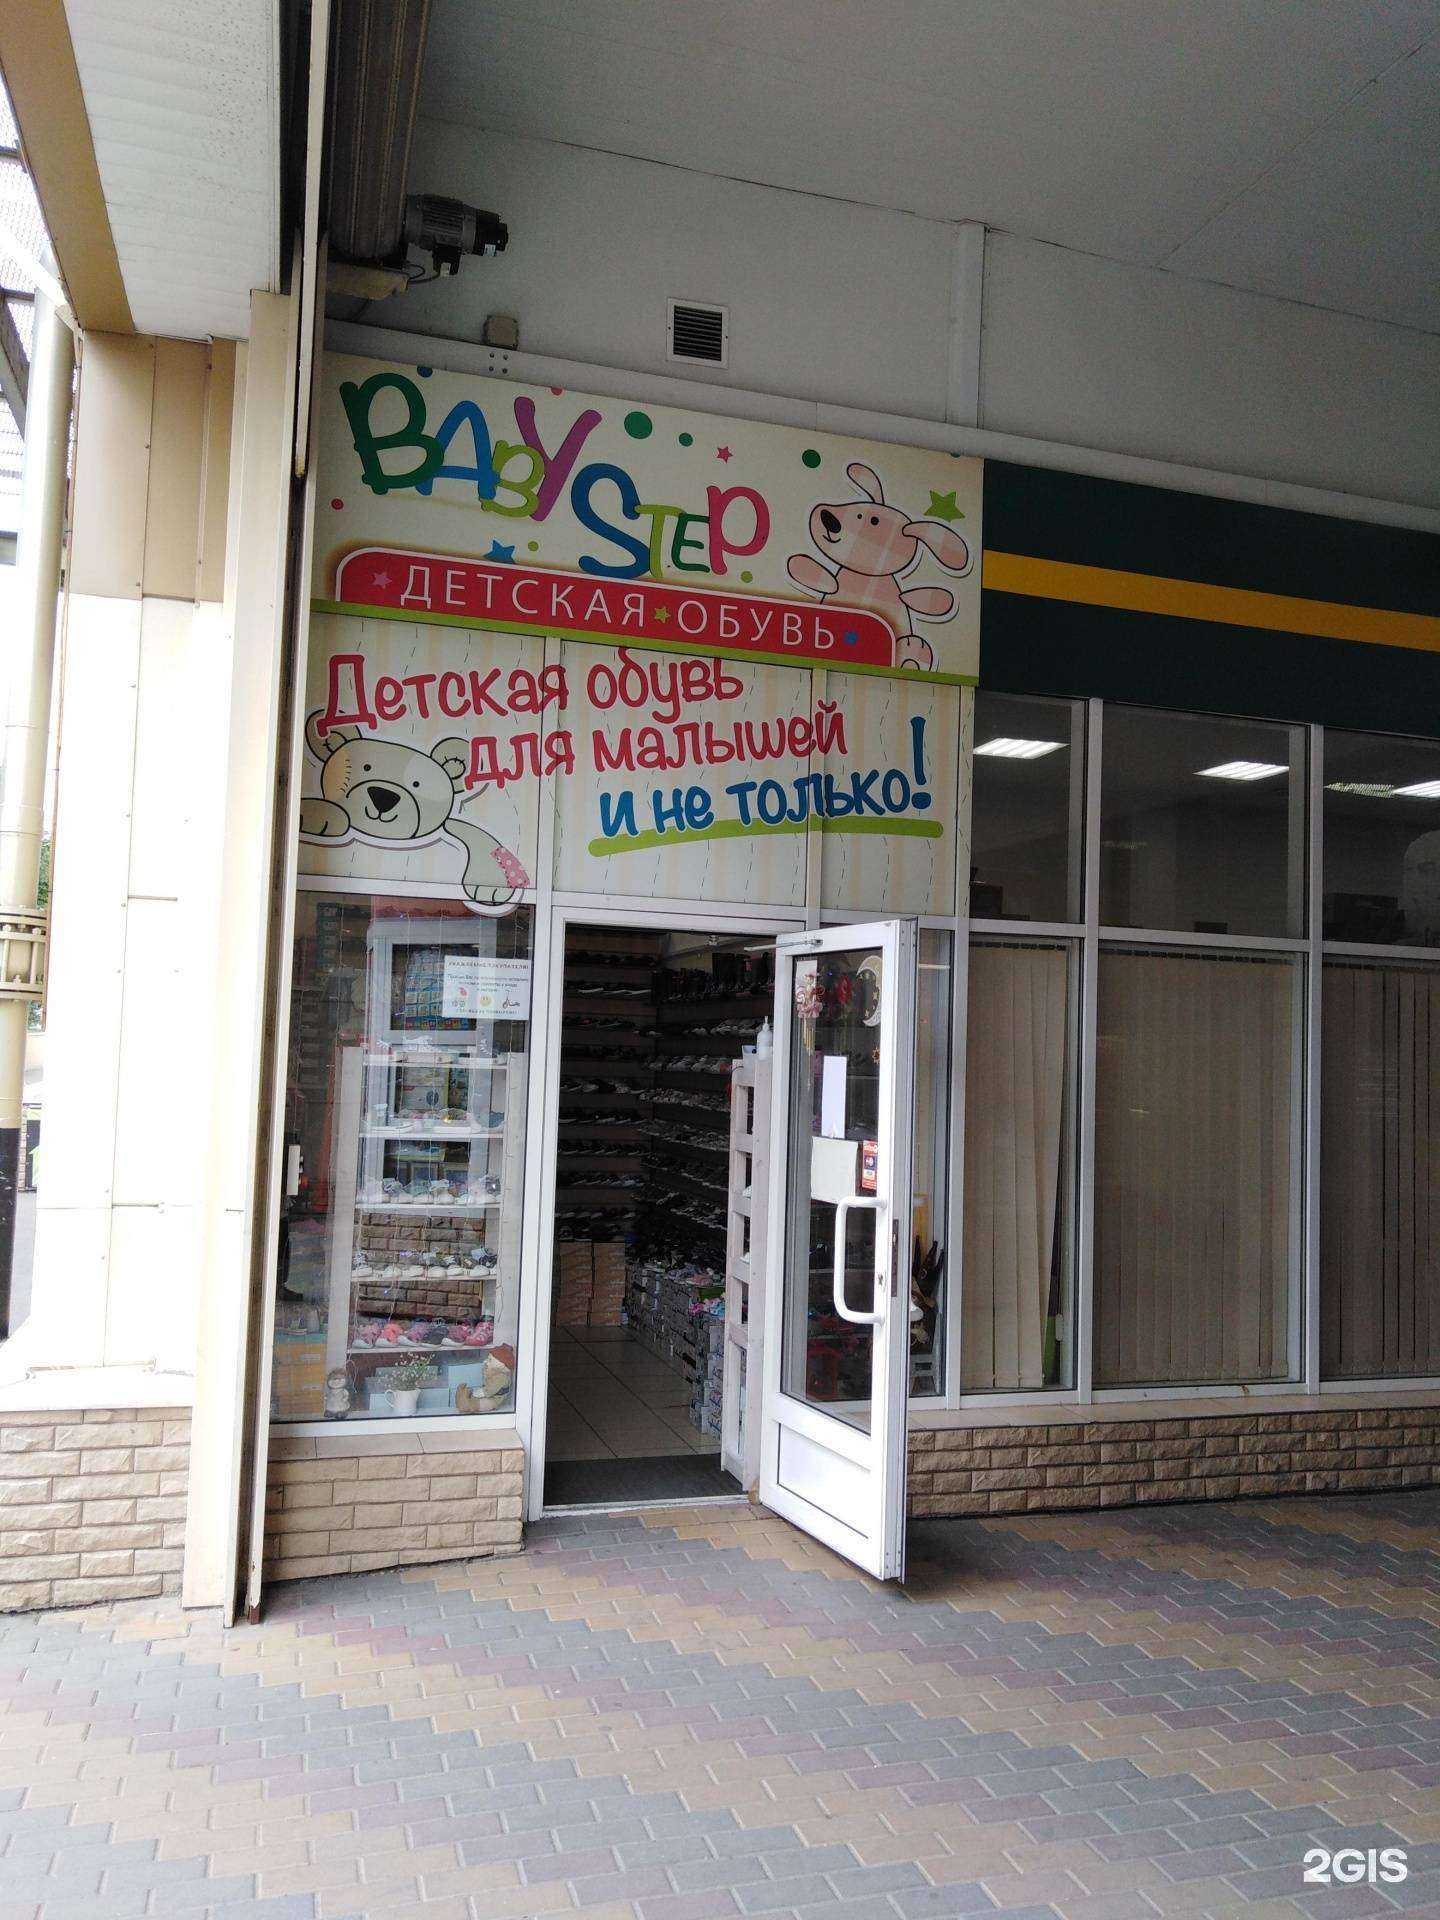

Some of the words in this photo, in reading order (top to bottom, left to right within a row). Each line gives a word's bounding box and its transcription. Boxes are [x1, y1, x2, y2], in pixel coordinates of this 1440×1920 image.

[339, 372, 602, 522] BABY
[571, 462, 770, 580] STEP
[400, 564, 646, 628] ДЕТСКАЯ
[677, 600, 835, 650] ОБУВЬ
[317, 654, 569, 737] Детская
[586, 646, 744, 725] обувь
[465, 729, 576, 790] для
[592, 700, 847, 774] малышей
[599, 788, 638, 837] и
[651, 784, 715, 836] не
[726, 715, 932, 826] только!
